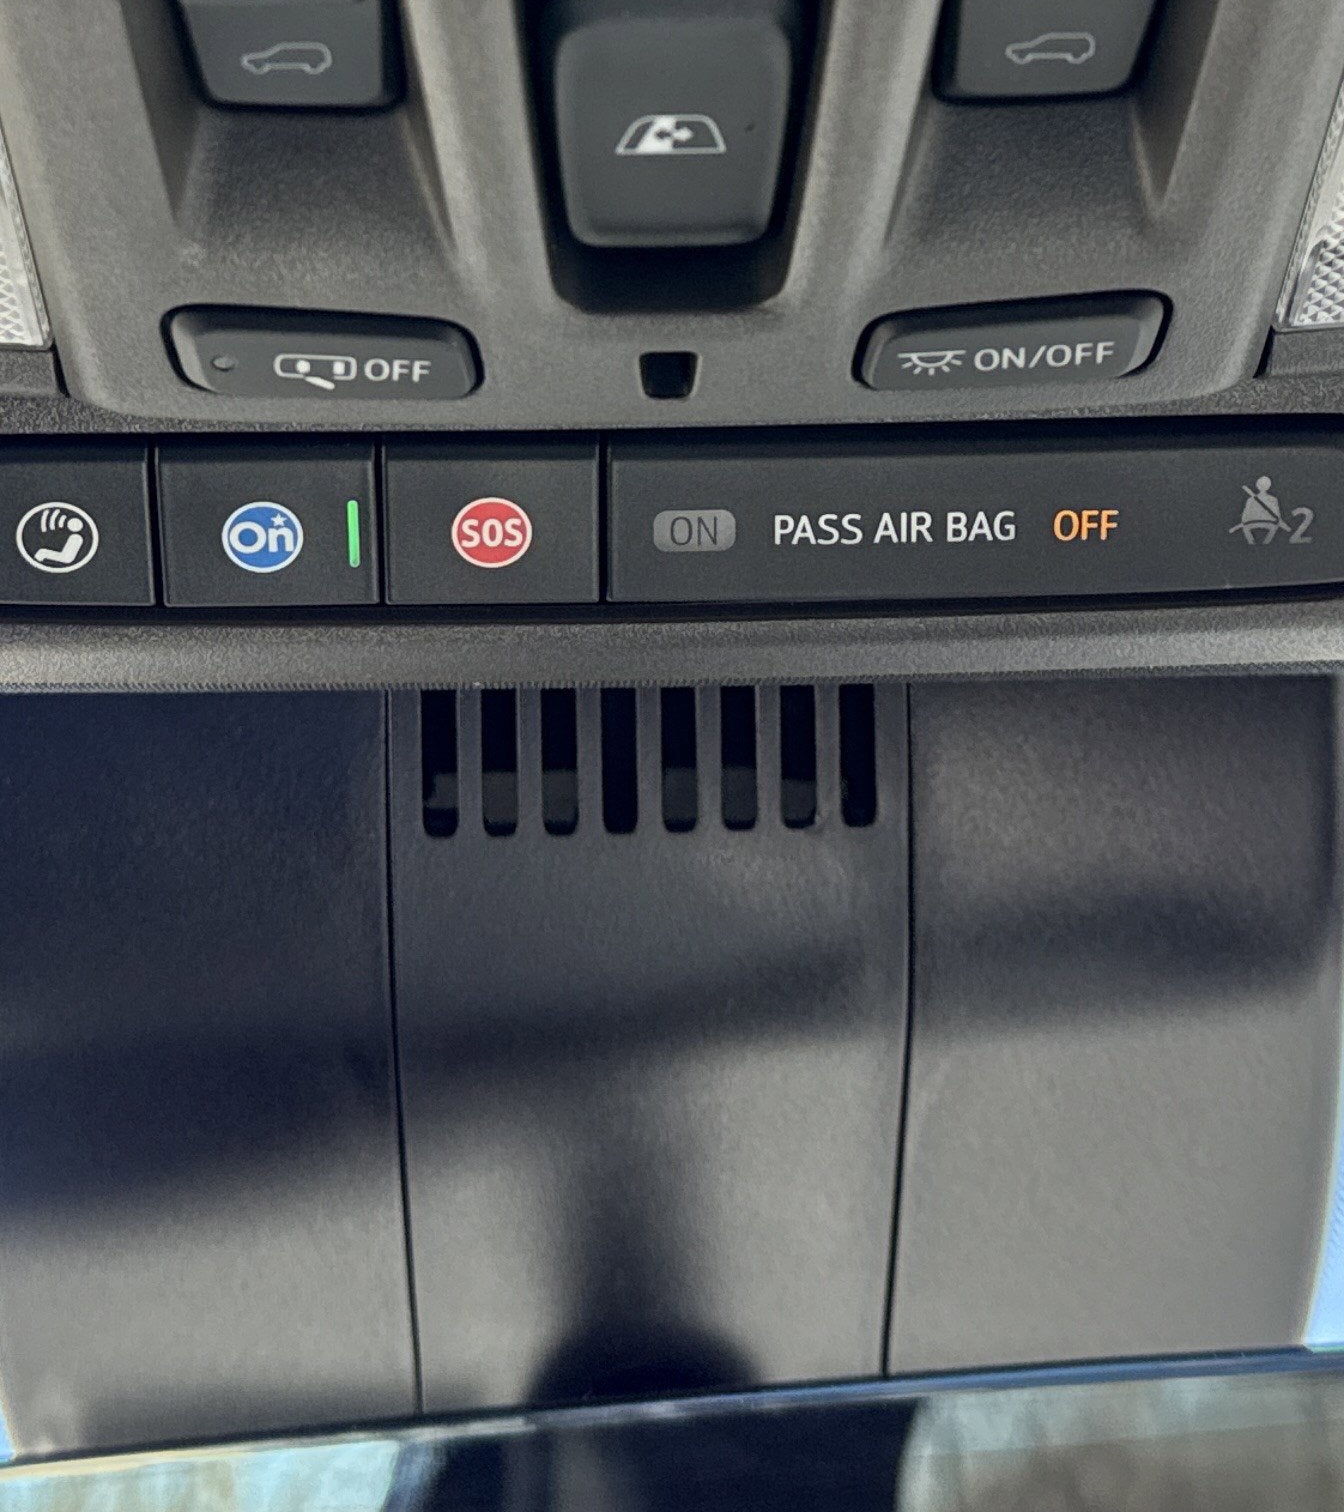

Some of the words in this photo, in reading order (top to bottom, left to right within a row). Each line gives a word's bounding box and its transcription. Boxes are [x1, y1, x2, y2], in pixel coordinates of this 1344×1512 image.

[364, 357, 432, 383] OFF
[973, 340, 1116, 372] ON/OFF
[229, 520, 294, 554] On
[460, 517, 523, 549] SOS
[670, 516, 719, 545] ON
[773, 513, 863, 545] PASS
[873, 511, 934, 544] AIR
[946, 510, 1017, 542] BAG
[1053, 509, 1120, 541] OFF
[1289, 506, 1313, 544] 2
